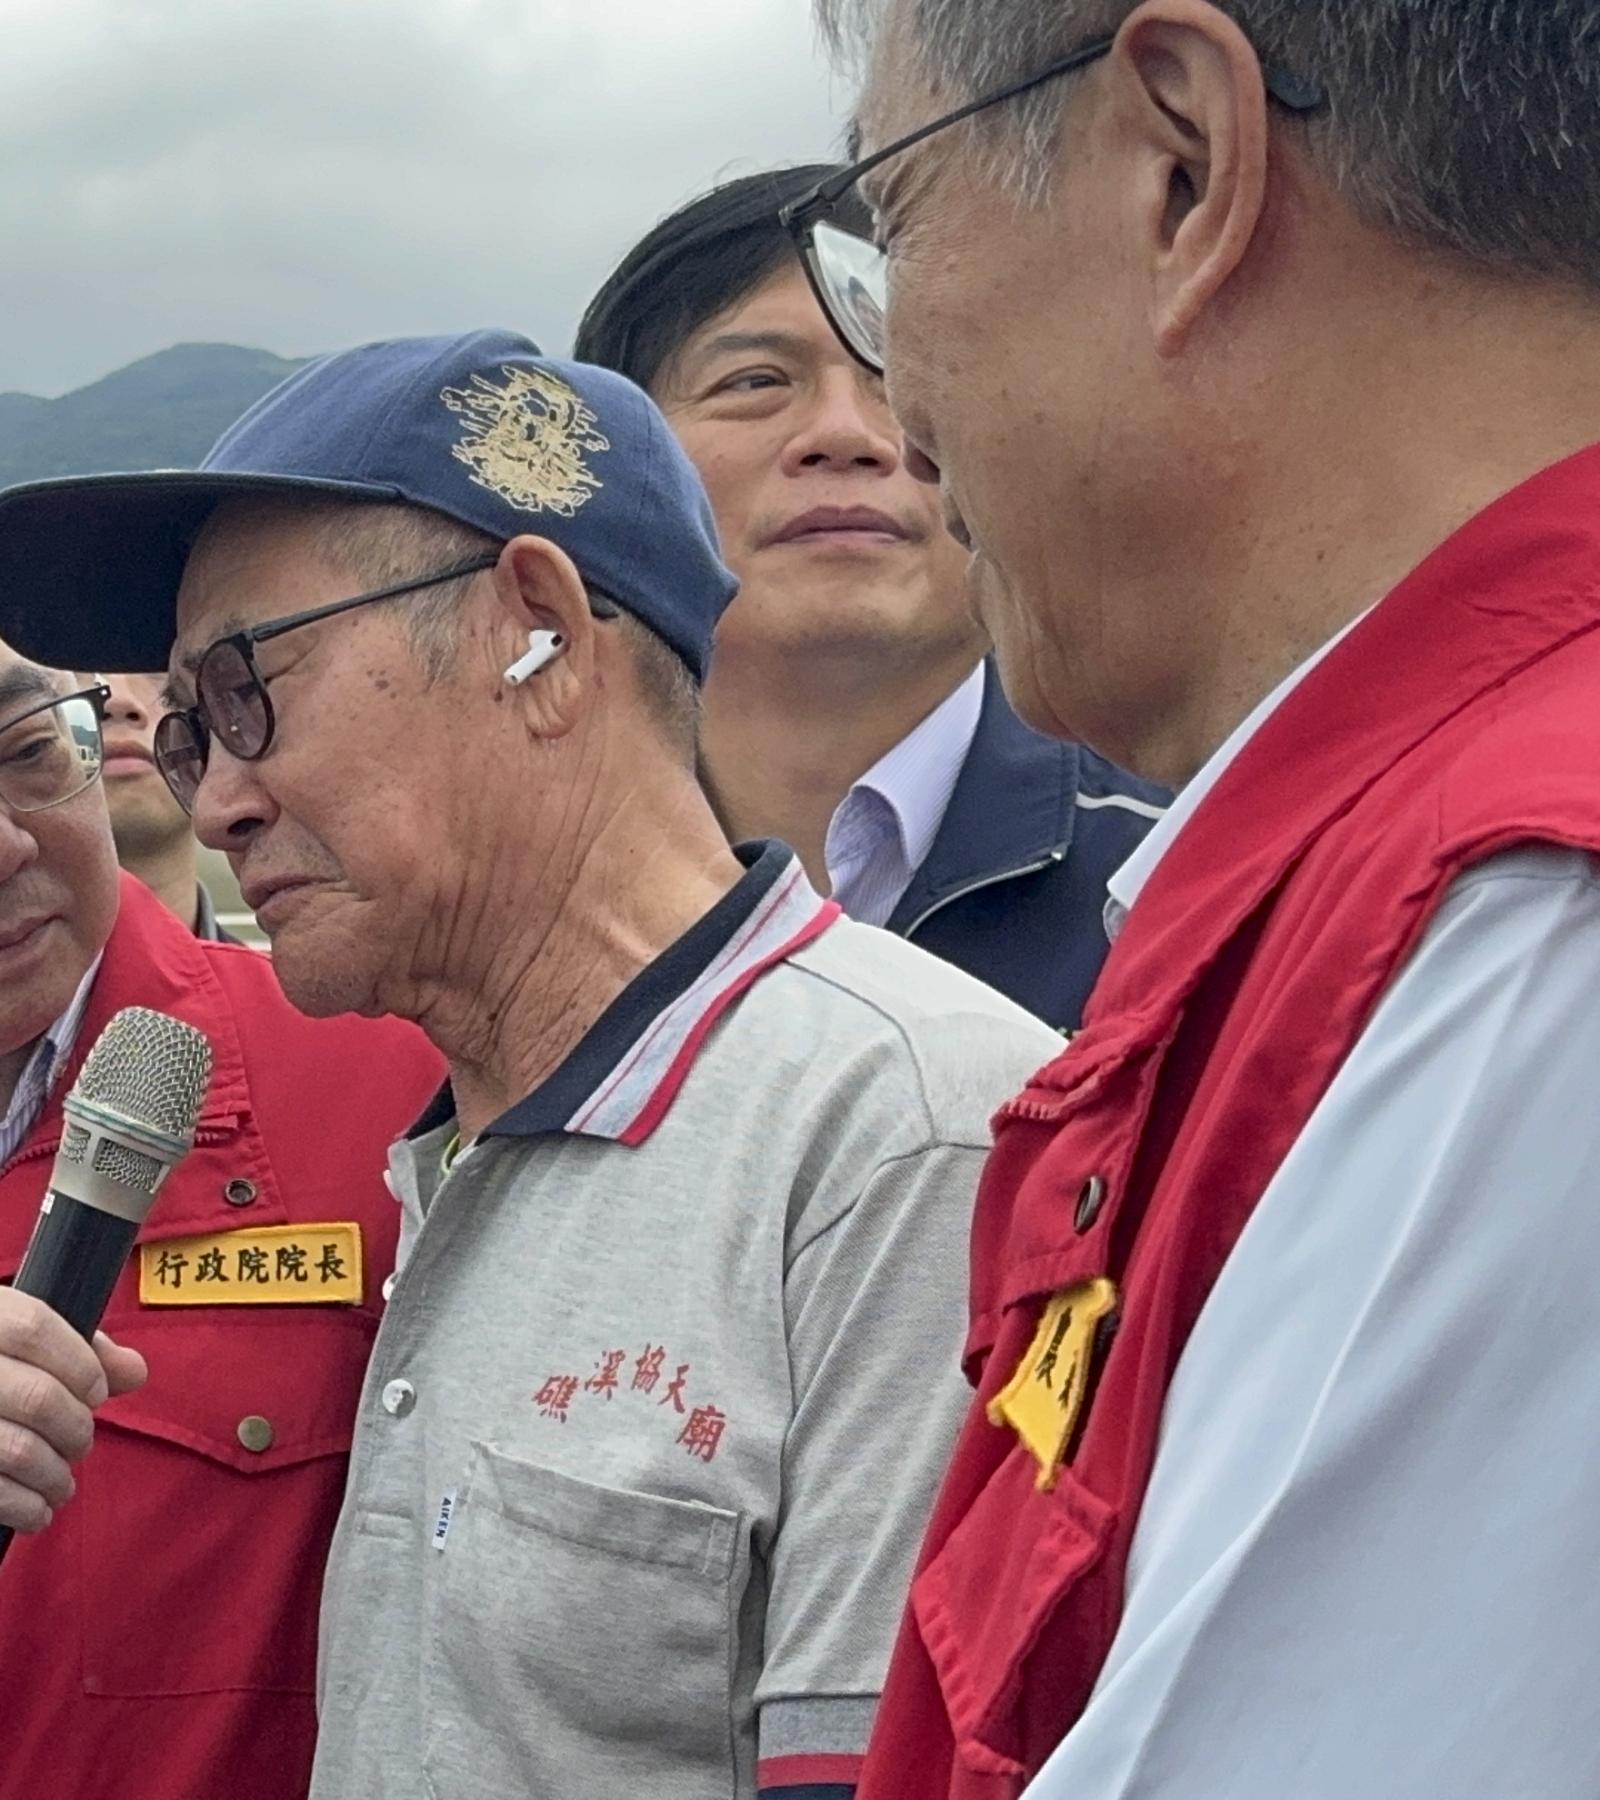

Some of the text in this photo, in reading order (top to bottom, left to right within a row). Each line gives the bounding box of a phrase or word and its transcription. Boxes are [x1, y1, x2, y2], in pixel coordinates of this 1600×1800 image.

[153, 1244, 347, 1288] 行政院院長
[531, 1343, 726, 1463] 礁溪協天廟
